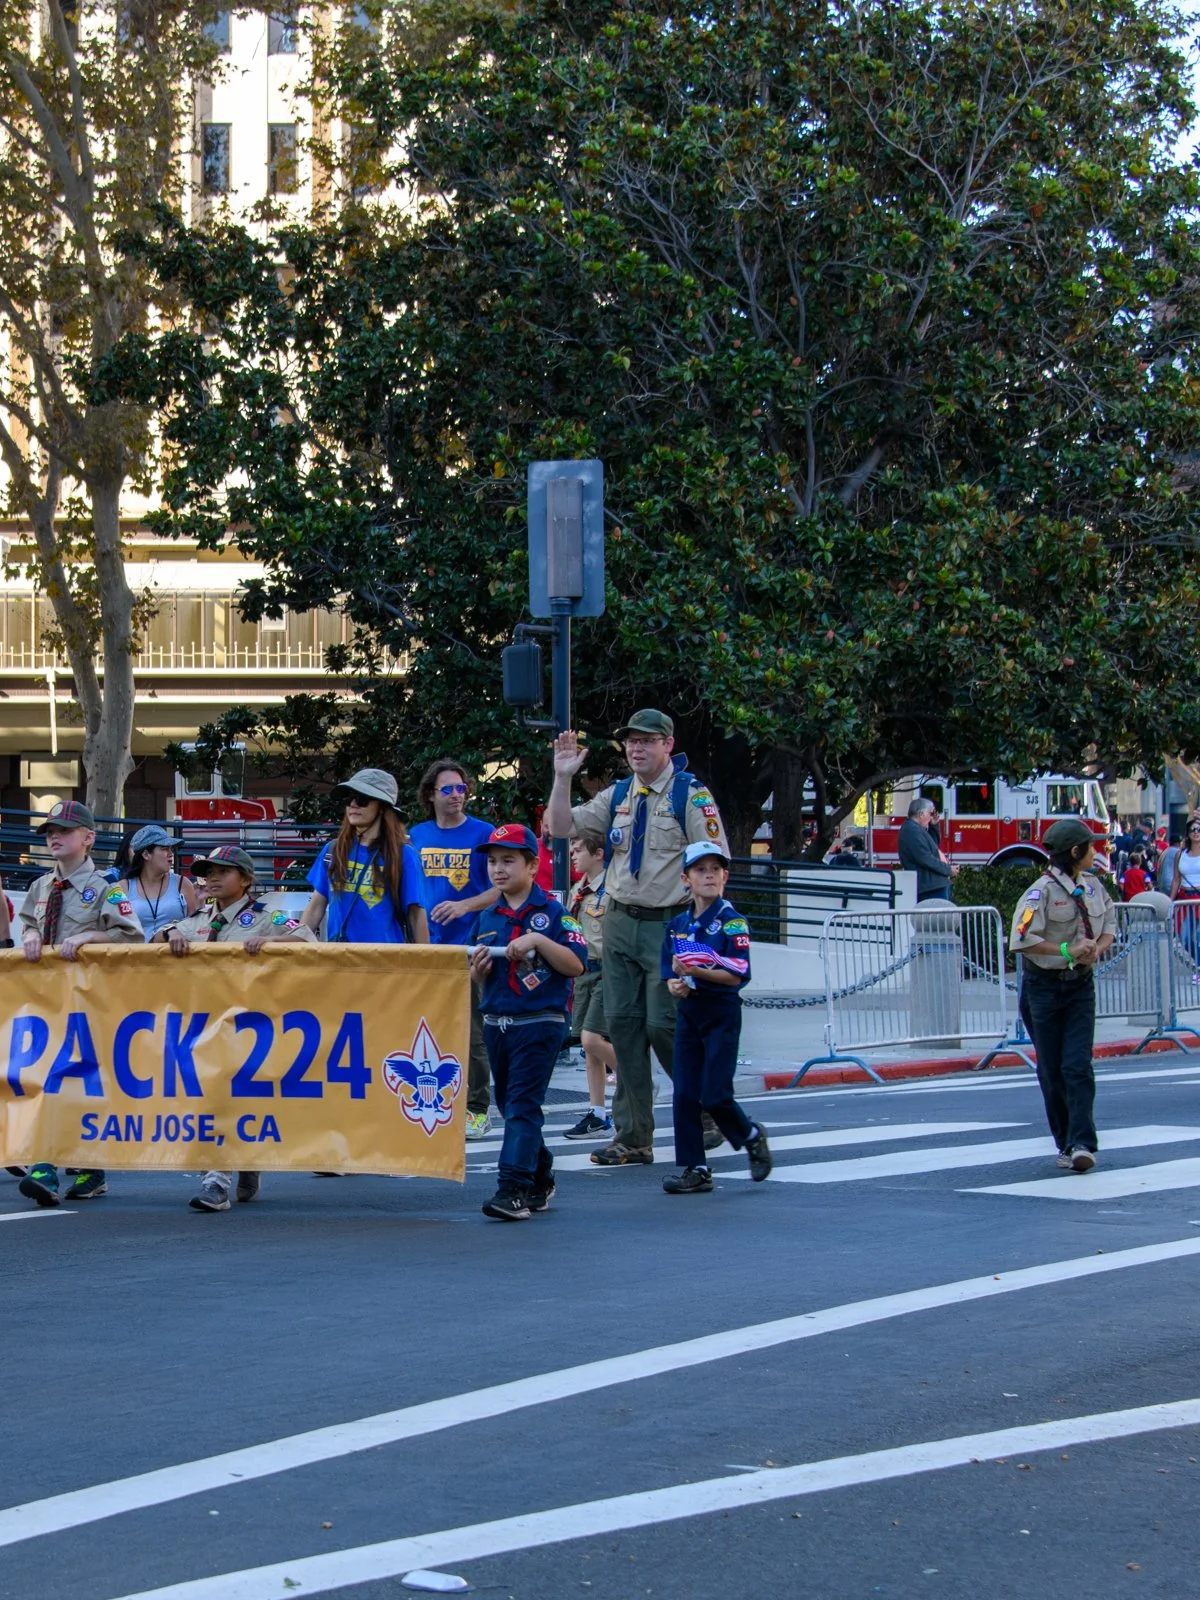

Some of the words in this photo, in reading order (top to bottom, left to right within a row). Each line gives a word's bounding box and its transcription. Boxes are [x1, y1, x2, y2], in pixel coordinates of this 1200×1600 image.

[421, 854, 447, 869] PACK
[449, 854, 471, 869] 224
[6, 1011, 211, 1098] PACK
[230, 1010, 373, 1100] 224
[80, 1113, 144, 1142] SAN
[150, 1114, 225, 1147] JOSE,
[236, 1114, 282, 1143] CA
